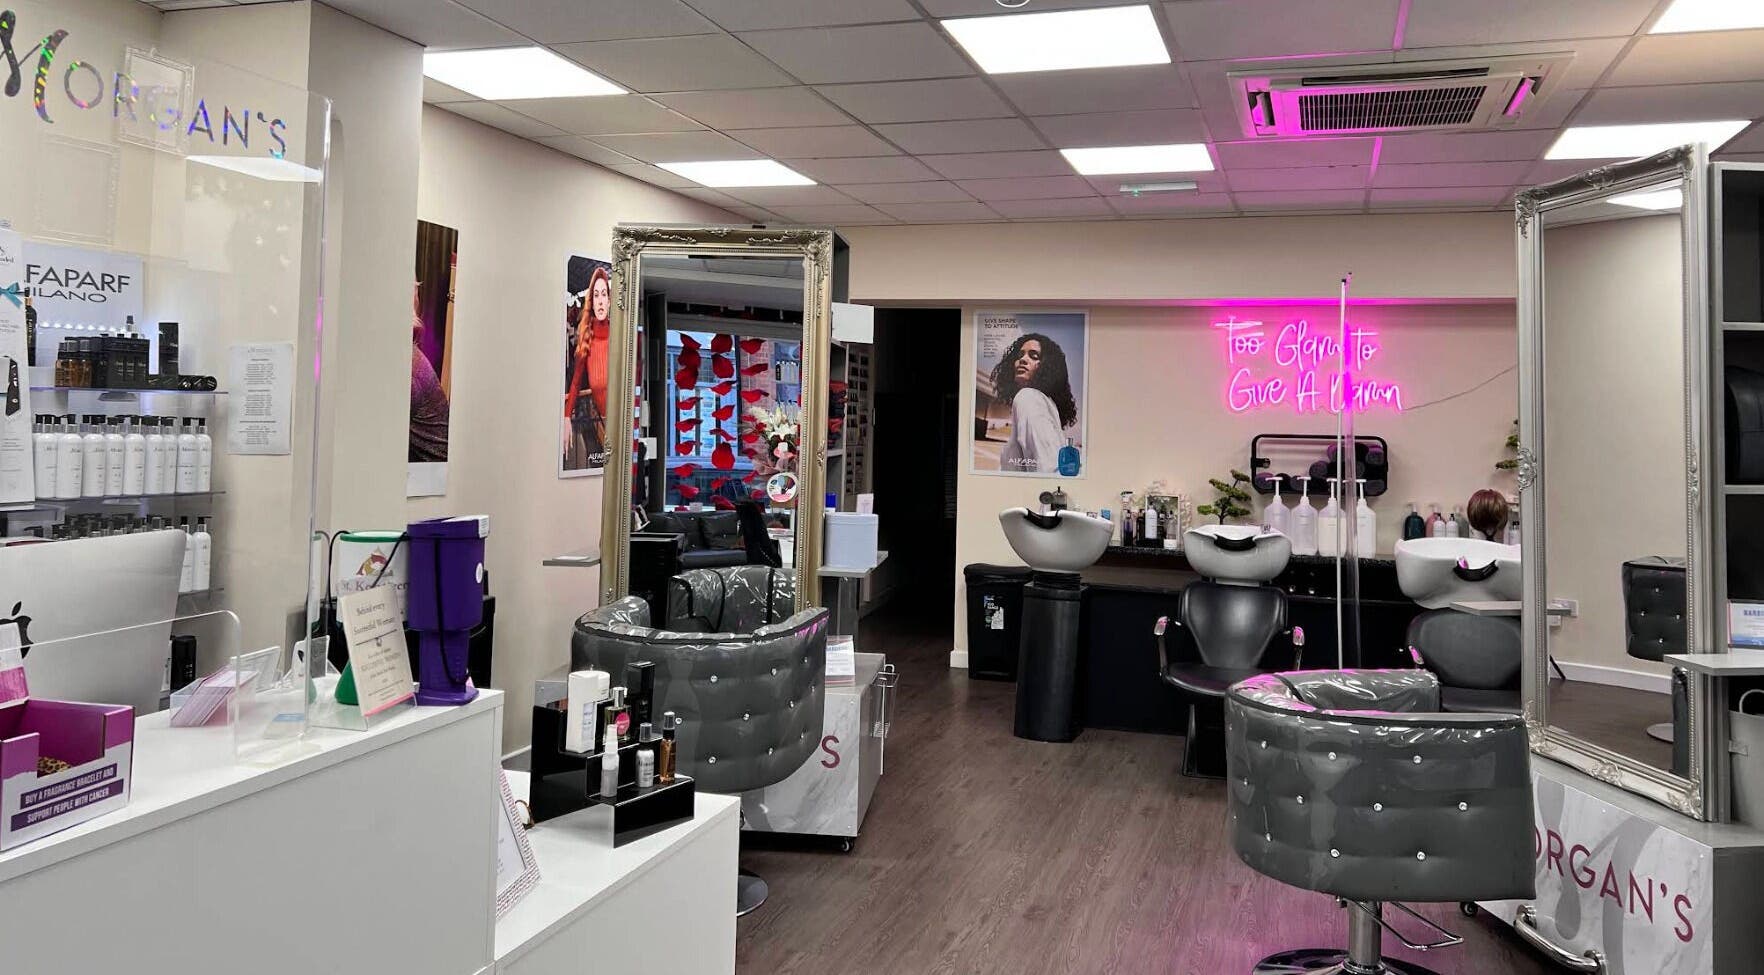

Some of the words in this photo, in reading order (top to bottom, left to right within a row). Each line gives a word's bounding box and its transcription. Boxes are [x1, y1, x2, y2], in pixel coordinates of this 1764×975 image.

[25, 264, 131, 293] FAPARF
[32, 287, 107, 303] ILANO
[1229, 368, 1287, 411] Give
[1296, 371, 1322, 412] A
[25, 793, 38, 805] BUY
[38, 790, 43, 800] A
[43, 781, 76, 799] FRAGRANCE
[76, 771, 102, 790] BRACELET
[102, 767, 114, 779] AND
[27, 807, 53, 823] SUPPORT
[53, 800, 73, 814] PEOPLE
[74, 794, 89, 808] WITH
[88, 787, 110, 802] CANCER
